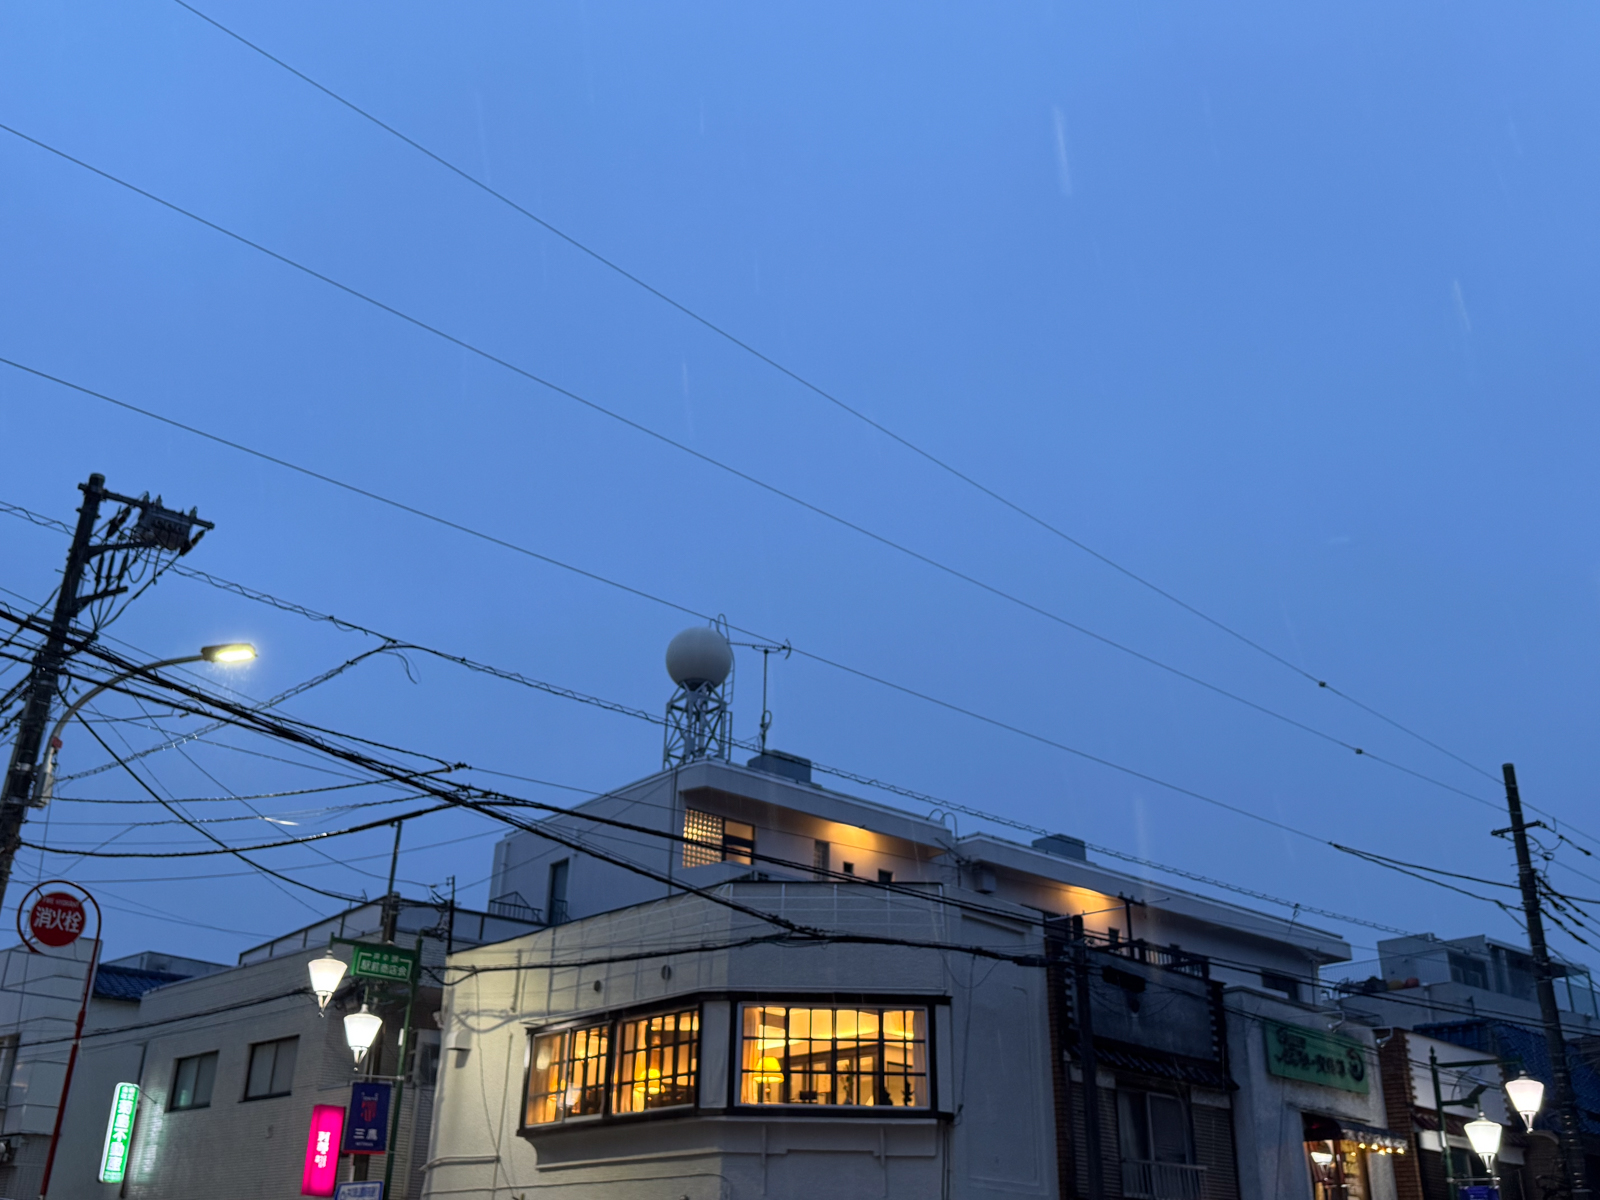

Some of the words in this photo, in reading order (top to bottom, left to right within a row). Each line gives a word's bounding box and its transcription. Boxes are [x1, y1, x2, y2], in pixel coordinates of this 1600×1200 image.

[33, 906, 82, 933] 消火栓
[360, 960, 407, 976] 駅前商店会
[353, 1128, 378, 1140] 三鷹
